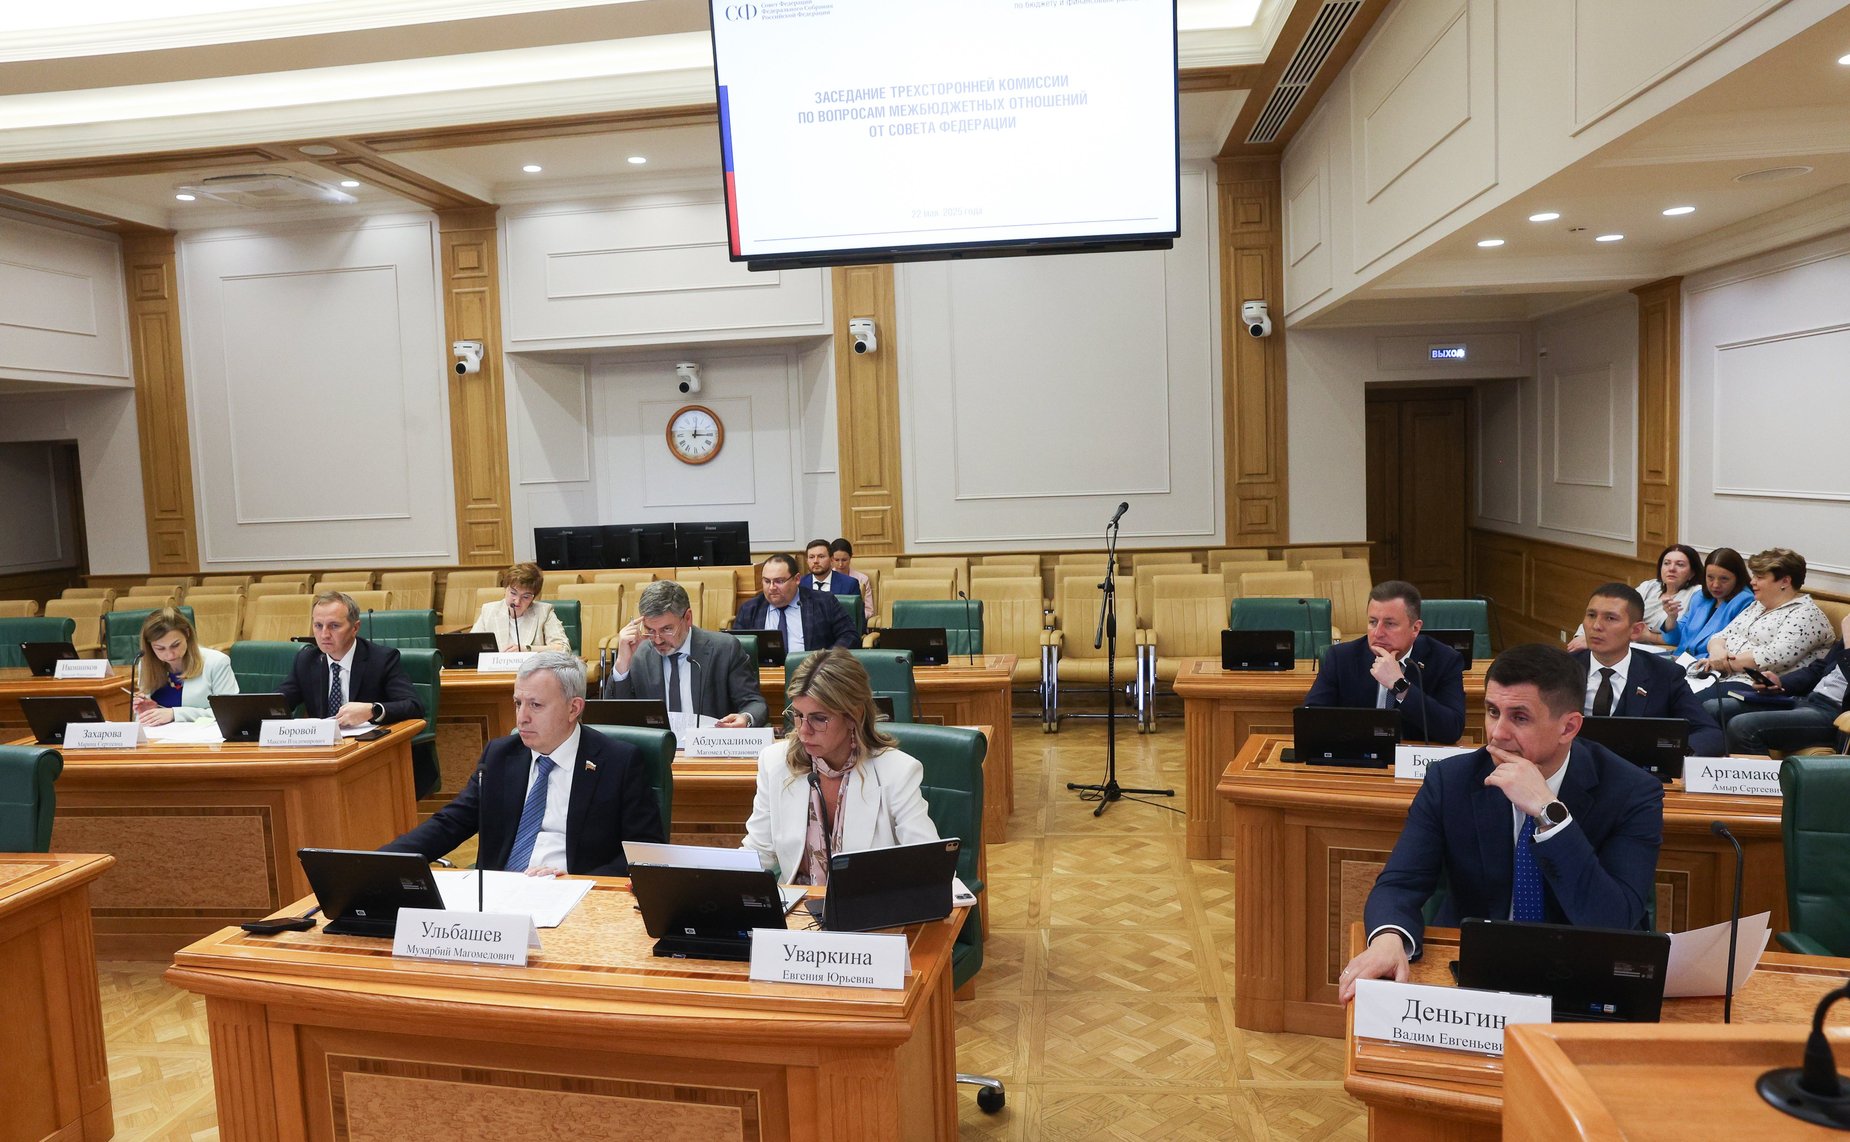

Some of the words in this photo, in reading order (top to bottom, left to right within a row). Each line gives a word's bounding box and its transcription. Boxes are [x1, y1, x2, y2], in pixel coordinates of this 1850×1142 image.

[725, 4, 757, 21] СФ
[814, 86, 887, 104] ЗАСЕДАНИЕ
[890, 76, 995, 99] ТРЕХСТОРОННЕЙ
[998, 74, 1070, 91] КОМИССИИ
[797, 111, 815, 124] ПО
[818, 105, 886, 122] ВОПРОСАМ
[889, 98, 1005, 118] МЕЖБЮДЖЕТНЫХ
[1009, 90, 1088, 111] ОТНОШЕНИЙ
[868, 125, 885, 138] ОТ
[888, 121, 936, 137] СОВЕТА
[939, 116, 1017, 134] ФЕДЕРАЦИИ
[83, 729, 122, 740] Захарова
[278, 725, 317, 737] Боровой
[692, 736, 763, 748] Абдулхалимов
[1701, 765, 1780, 782] Аргамако
[1712, 783, 1738, 793] Амыр
[1739, 784, 1781, 794] Сергееви
[421, 921, 502, 943] Ульбашев
[406, 944, 451, 957] Мухарбий
[453, 947, 515, 961] Магомедович
[783, 944, 873, 968] Уваркина
[782, 969, 824, 982] Евгения
[827, 971, 874, 985] Юрьевна
[1401, 998, 1507, 1030] Деньгин
[1392, 1026, 1435, 1043] Вадим
